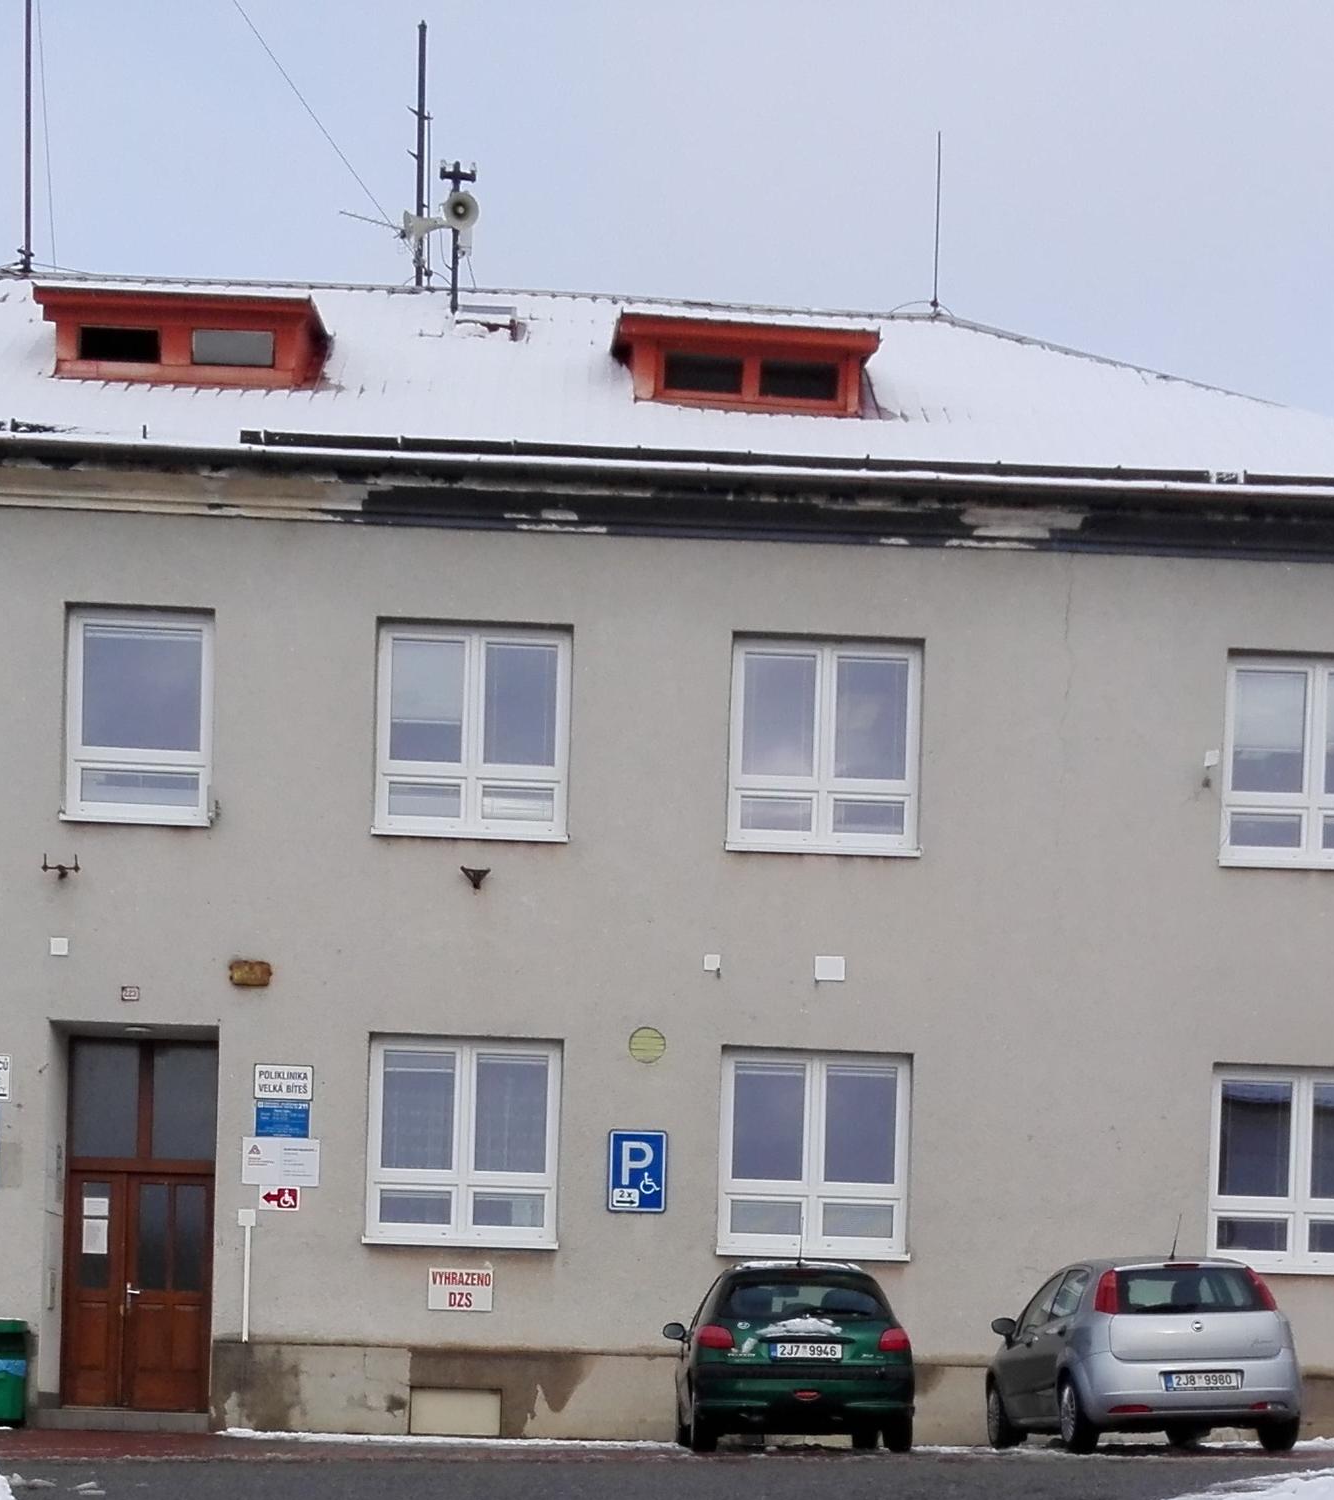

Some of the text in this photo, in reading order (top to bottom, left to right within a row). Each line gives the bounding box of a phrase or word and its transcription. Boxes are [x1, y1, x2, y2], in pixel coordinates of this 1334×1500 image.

[259, 1070, 308, 1081] POLIKLINIKA
[258, 1082, 308, 1094] VELKÁ BÍTEŠ
[621, 1141, 654, 1185] P
[432, 1271, 491, 1286] VYHRAZENO
[448, 1291, 472, 1308] DZS
[779, 1345, 837, 1356] 2J7 9946
[1175, 1374, 1232, 1386] 2J8 9980
